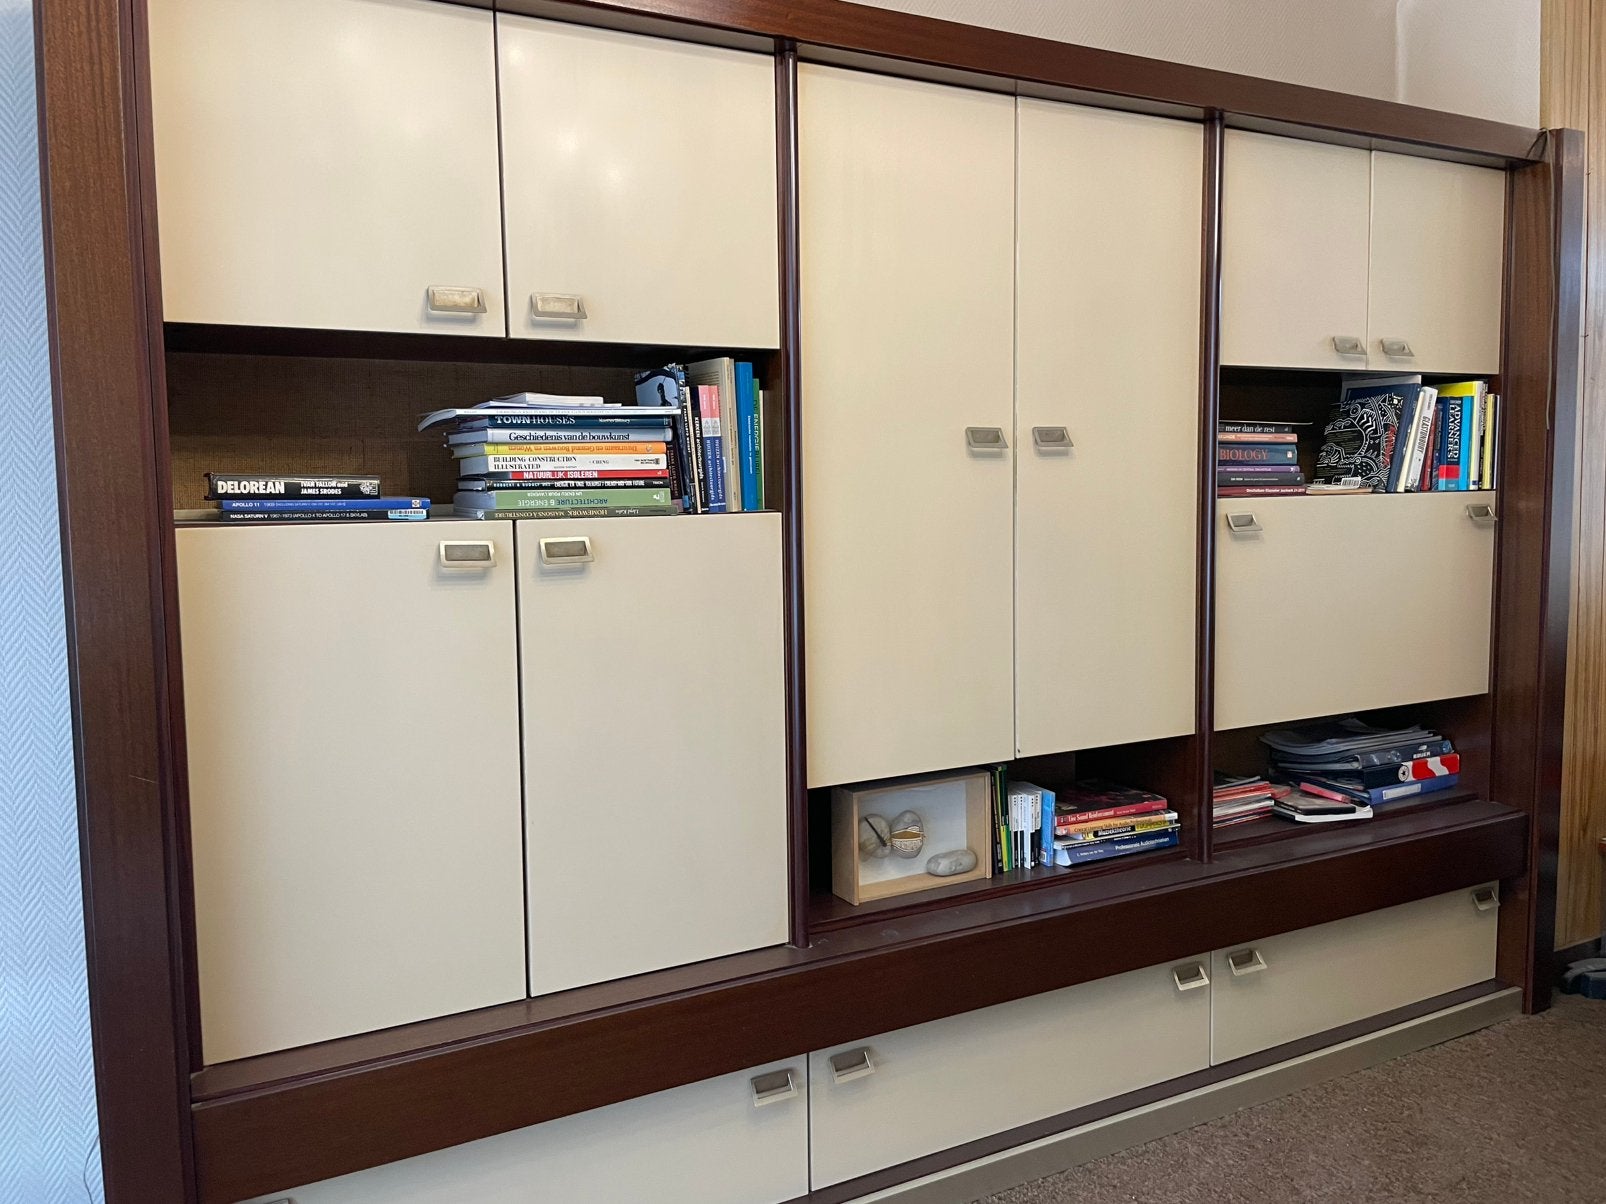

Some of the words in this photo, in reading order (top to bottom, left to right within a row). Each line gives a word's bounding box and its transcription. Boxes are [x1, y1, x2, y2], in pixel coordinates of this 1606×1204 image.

[508, 432, 562, 442] Geschiedenis
[578, 432, 588, 440] de
[588, 432, 630, 441] bouwkunst
[1418, 416, 1430, 454] GLASTONBURY
[1220, 449, 1269, 460] BIOLOGY
[217, 480, 285, 494] DELOREAN
[1076, 812, 1089, 821] Sound
